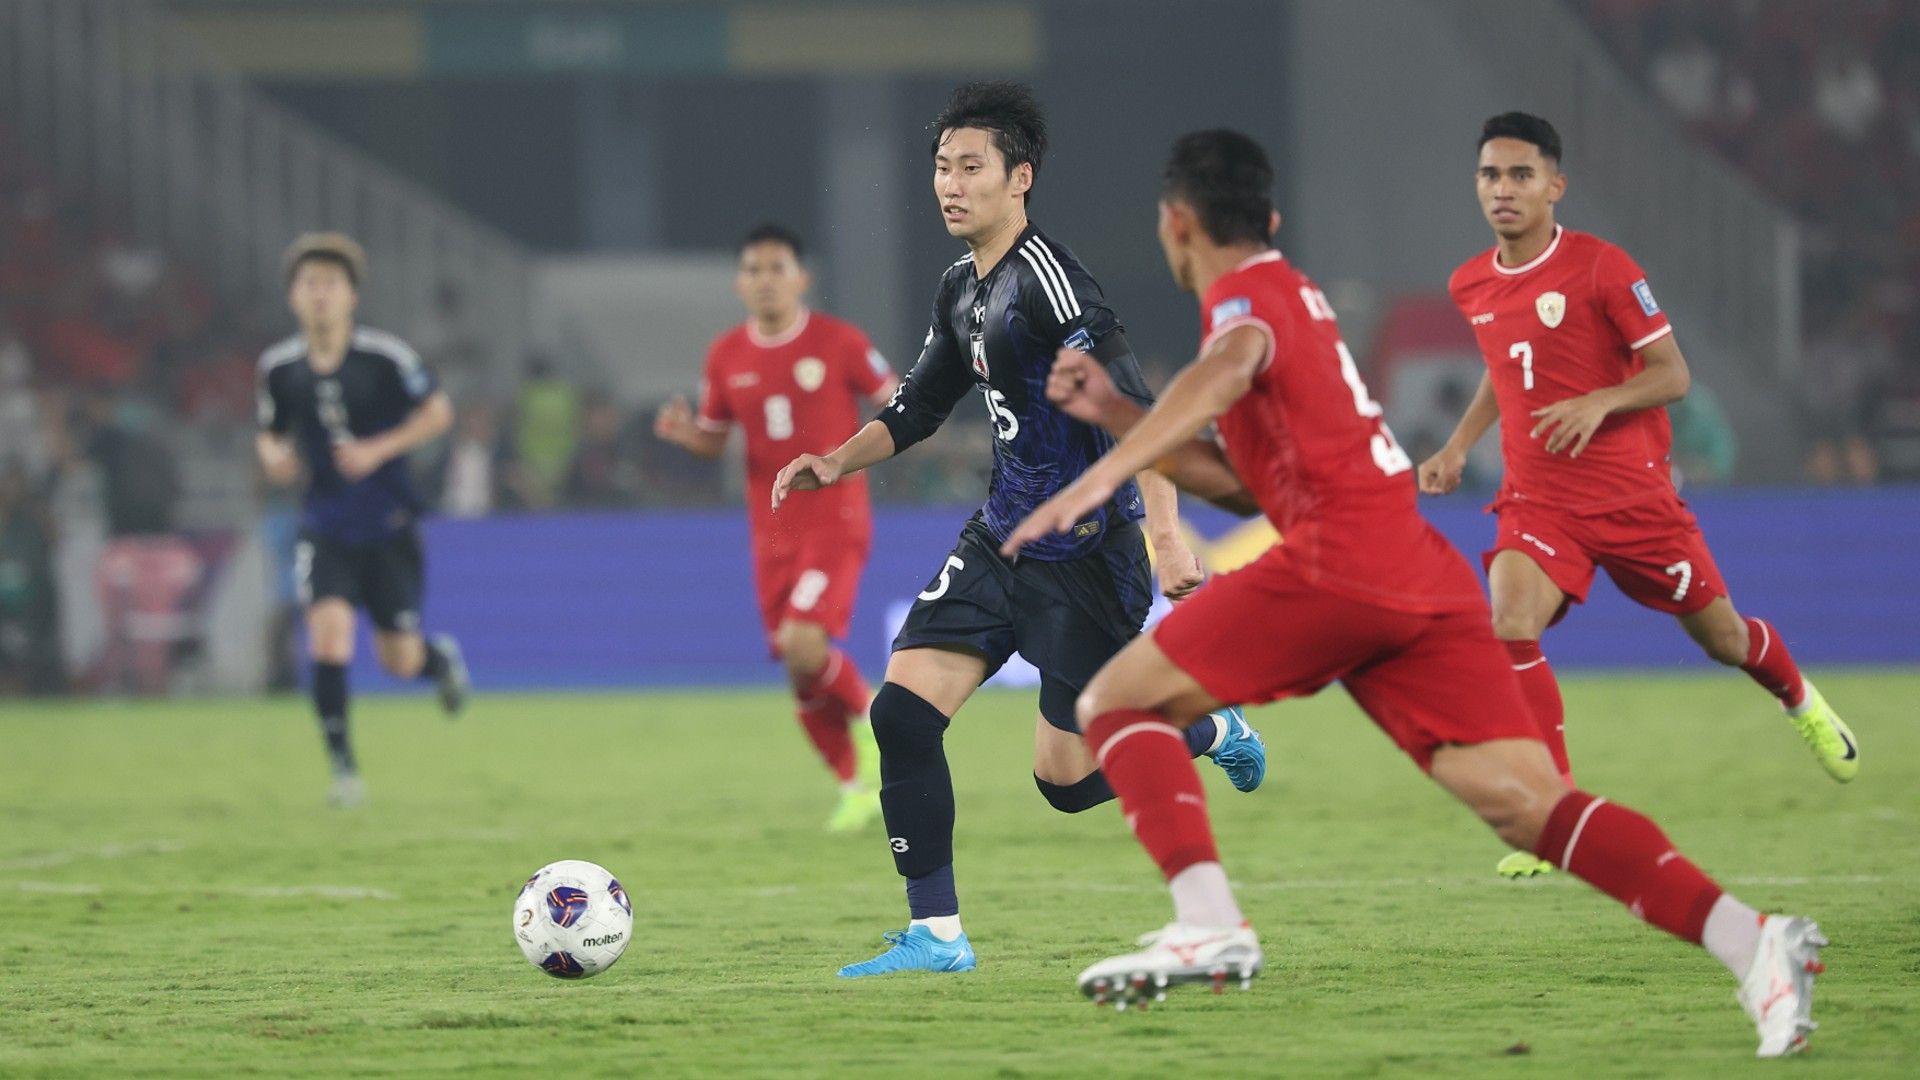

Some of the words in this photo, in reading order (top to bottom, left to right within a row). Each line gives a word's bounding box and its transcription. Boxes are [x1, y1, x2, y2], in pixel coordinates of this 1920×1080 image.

[1509, 340, 1534, 390] 7
[984, 389, 1020, 442] 15
[1665, 560, 1692, 601] 7
[583, 931, 624, 948] molten
